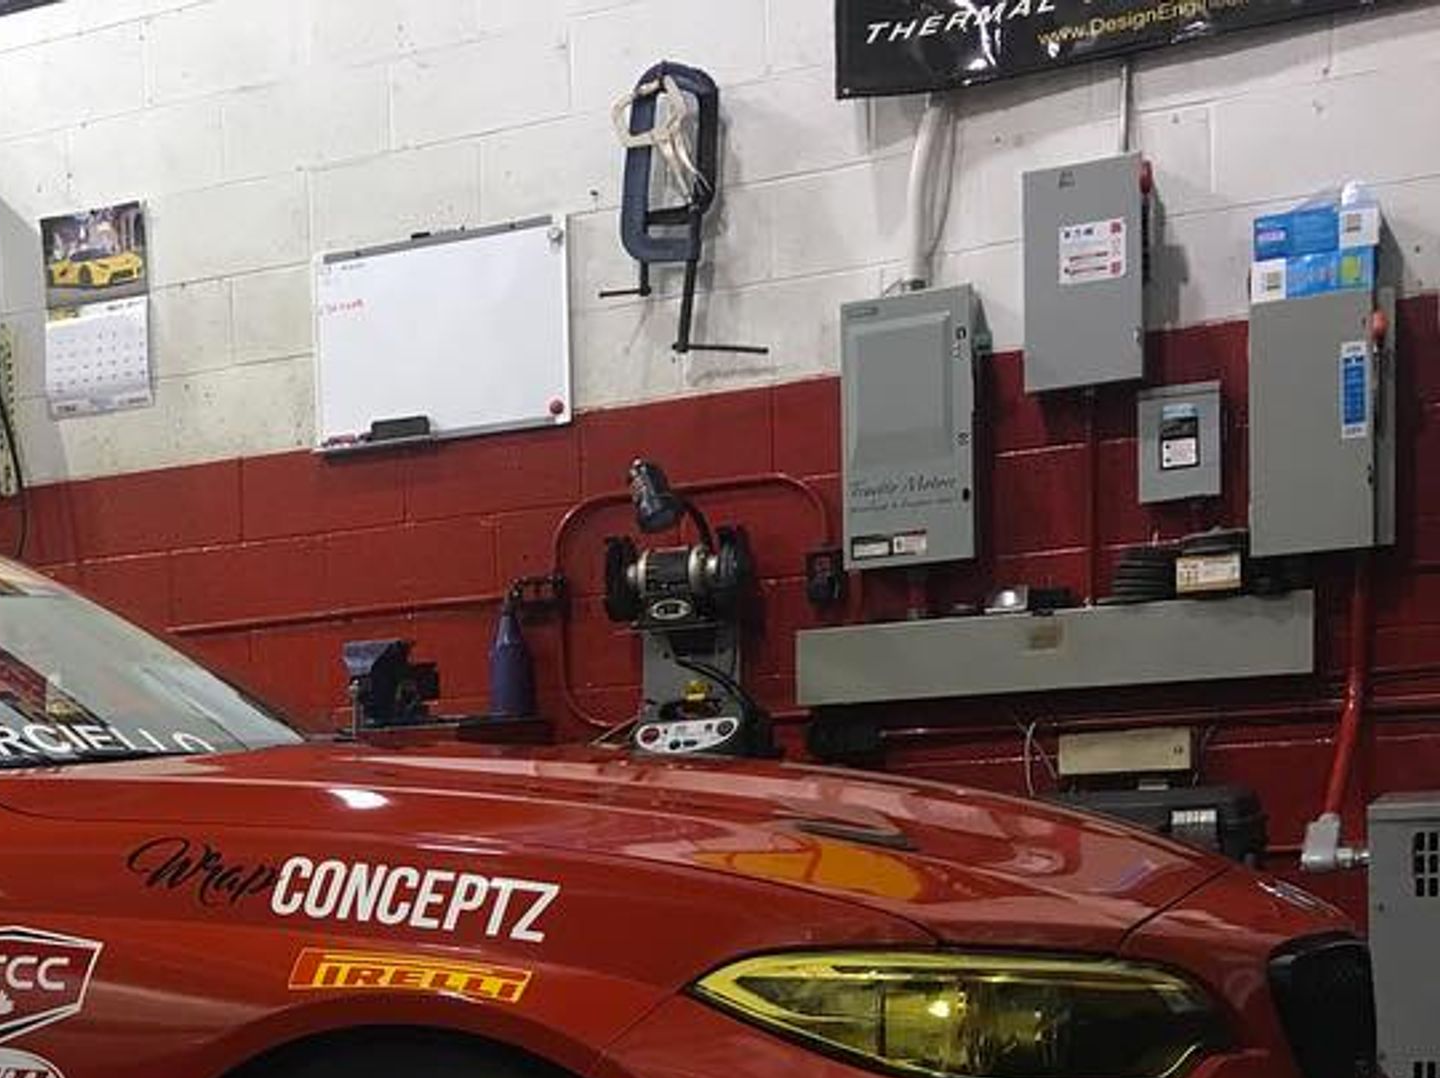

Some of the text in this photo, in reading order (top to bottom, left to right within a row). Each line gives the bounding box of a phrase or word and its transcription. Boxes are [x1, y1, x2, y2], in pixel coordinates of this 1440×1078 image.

[126, 837, 560, 943] Wrap CONCEPTZ
[288, 947, 533, 1003] PIRELLI
